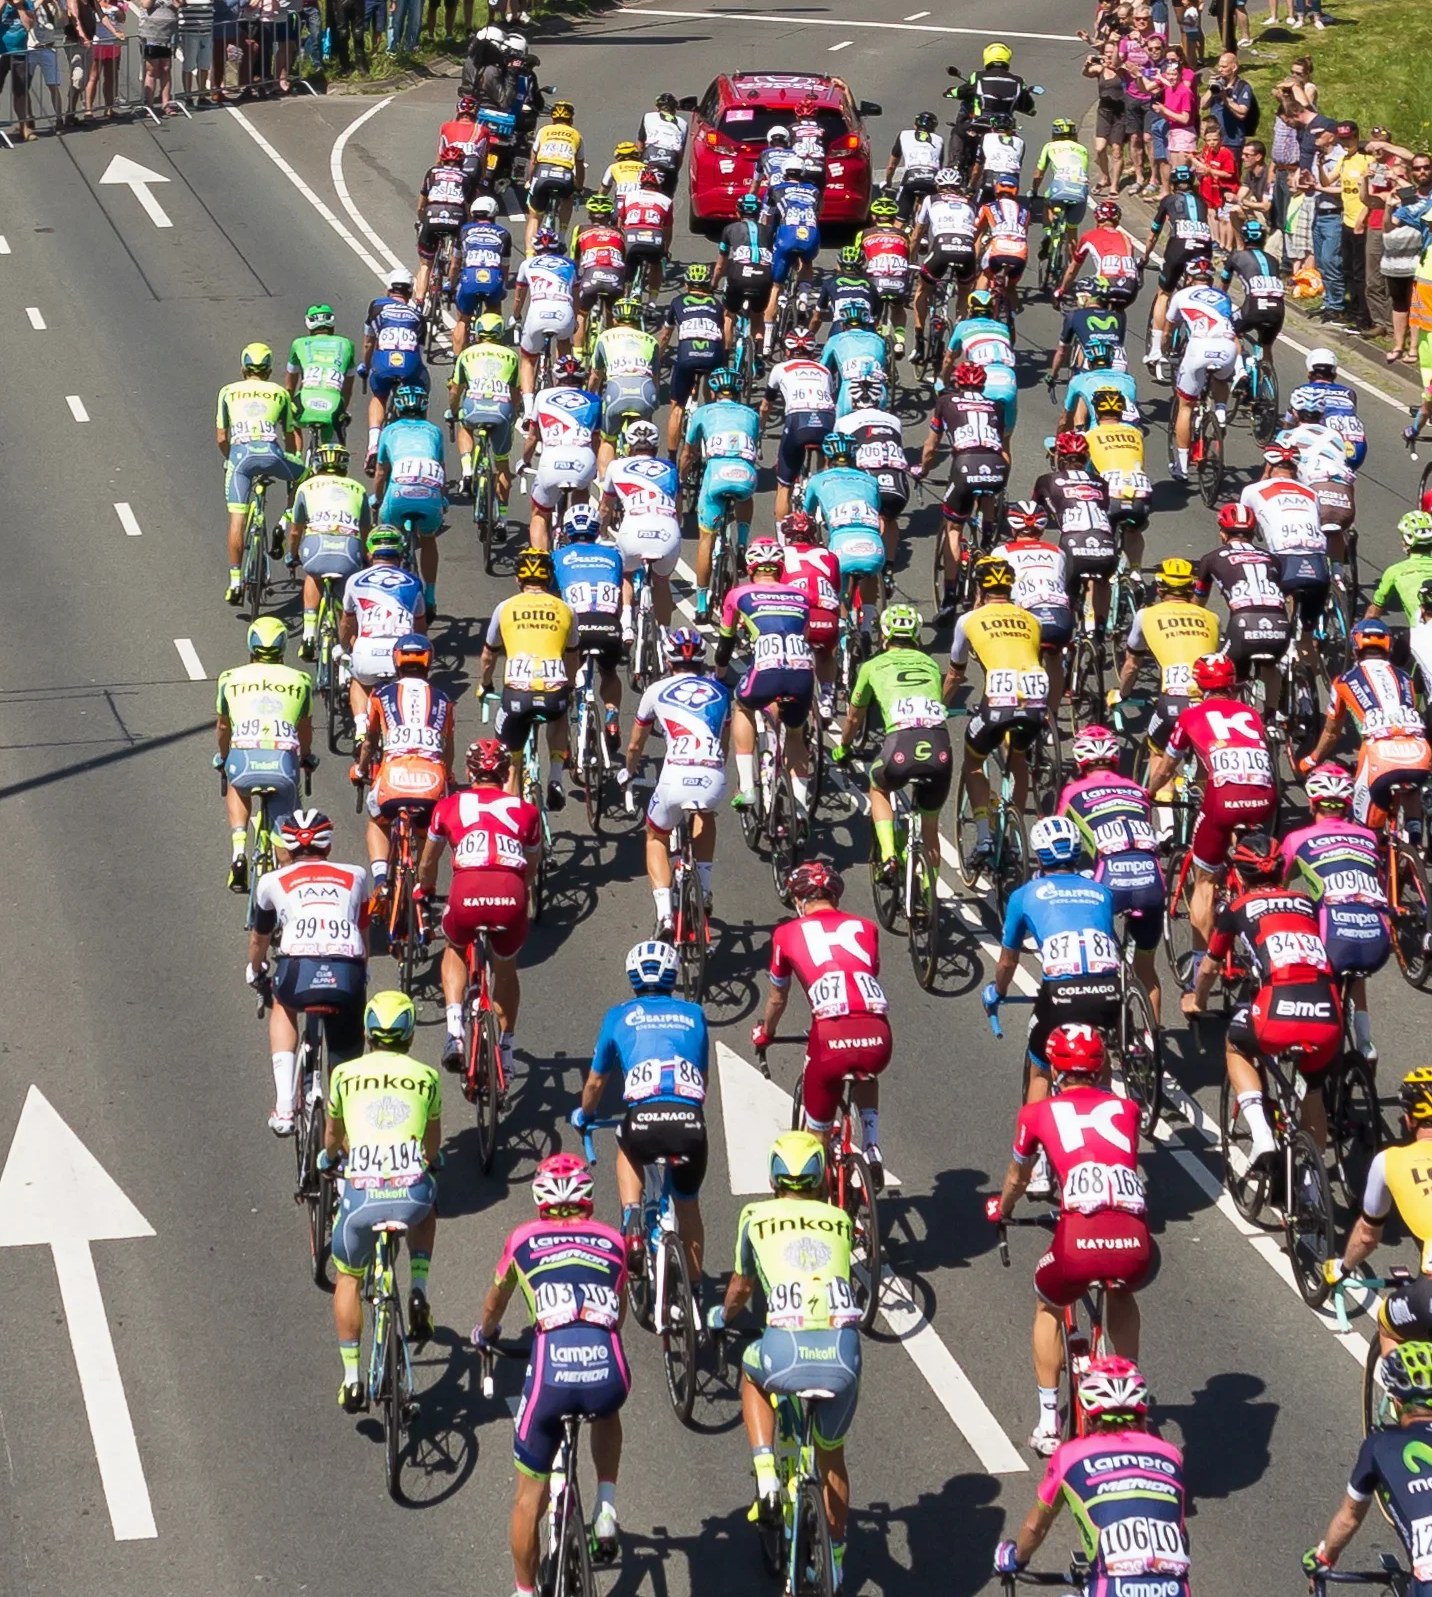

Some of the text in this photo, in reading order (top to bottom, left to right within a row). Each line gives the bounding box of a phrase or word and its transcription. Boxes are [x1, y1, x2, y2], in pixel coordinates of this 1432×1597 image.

[1072, 547, 1114, 557] RENSON
[1244, 630, 1286, 640] RENSON
[989, 672, 1047, 695] 175 175
[1165, 666, 1190, 685] 173
[230, 682, 302, 699] Tinkoff
[298, 888, 339, 899] IAM
[463, 897, 517, 907] KATUSHA
[1246, 898, 1314, 914] BMC
[1050, 936, 1070, 958] 87
[1057, 984, 1116, 996] COLNAGO
[1275, 1000, 1331, 1018] BMC
[828, 1037, 884, 1050] KATUSHA
[630, 1061, 653, 1086] 86
[636, 1111, 696, 1122] COLNAGO
[350, 1145, 383, 1173] 194
[1067, 1166, 1104, 1196] 168
[1076, 1237, 1141, 1250] KATUSHA
[536, 1284, 573, 1310] 103
[799, 1346, 837, 1361] Tinkoff
[554, 1368, 609, 1383] MERIDA
[1104, 1520, 1148, 1555] 106
